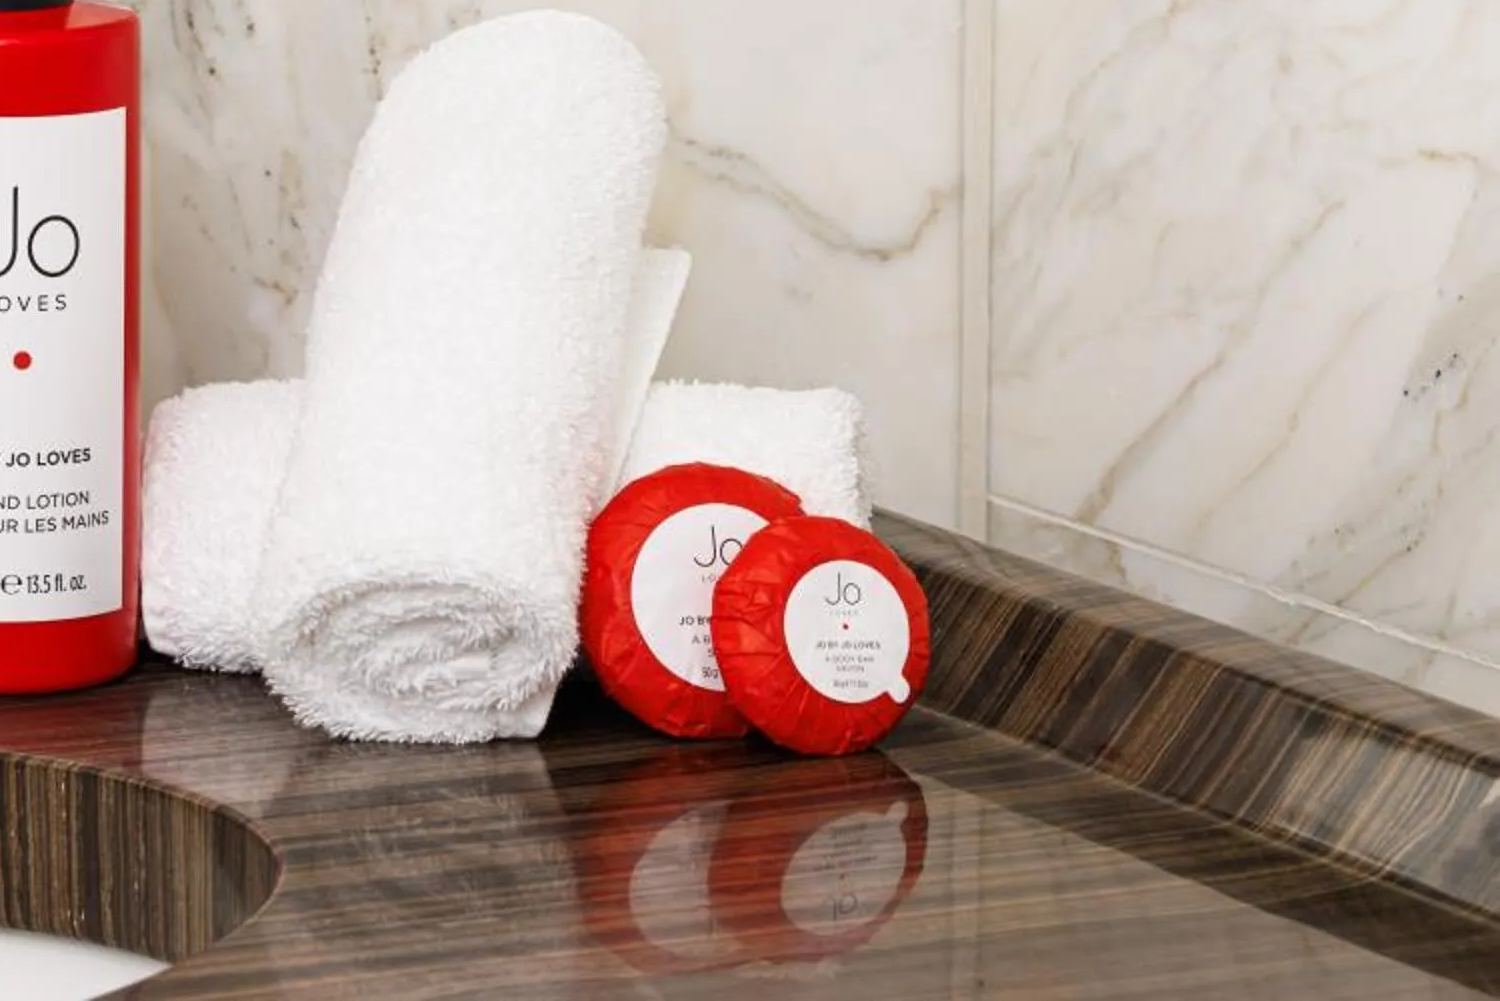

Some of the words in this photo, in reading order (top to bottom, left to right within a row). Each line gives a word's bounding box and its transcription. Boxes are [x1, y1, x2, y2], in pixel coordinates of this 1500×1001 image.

[5, 451, 32, 468] JO
[36, 447, 92, 467] LOVES
[26, 491, 90, 510] LOTION
[24, 516, 58, 534] LES
[61, 510, 109, 531] MAINS
[26, 574, 52, 595] 13.5
[824, 571, 861, 606] Jo
[679, 615, 695, 626] JO
